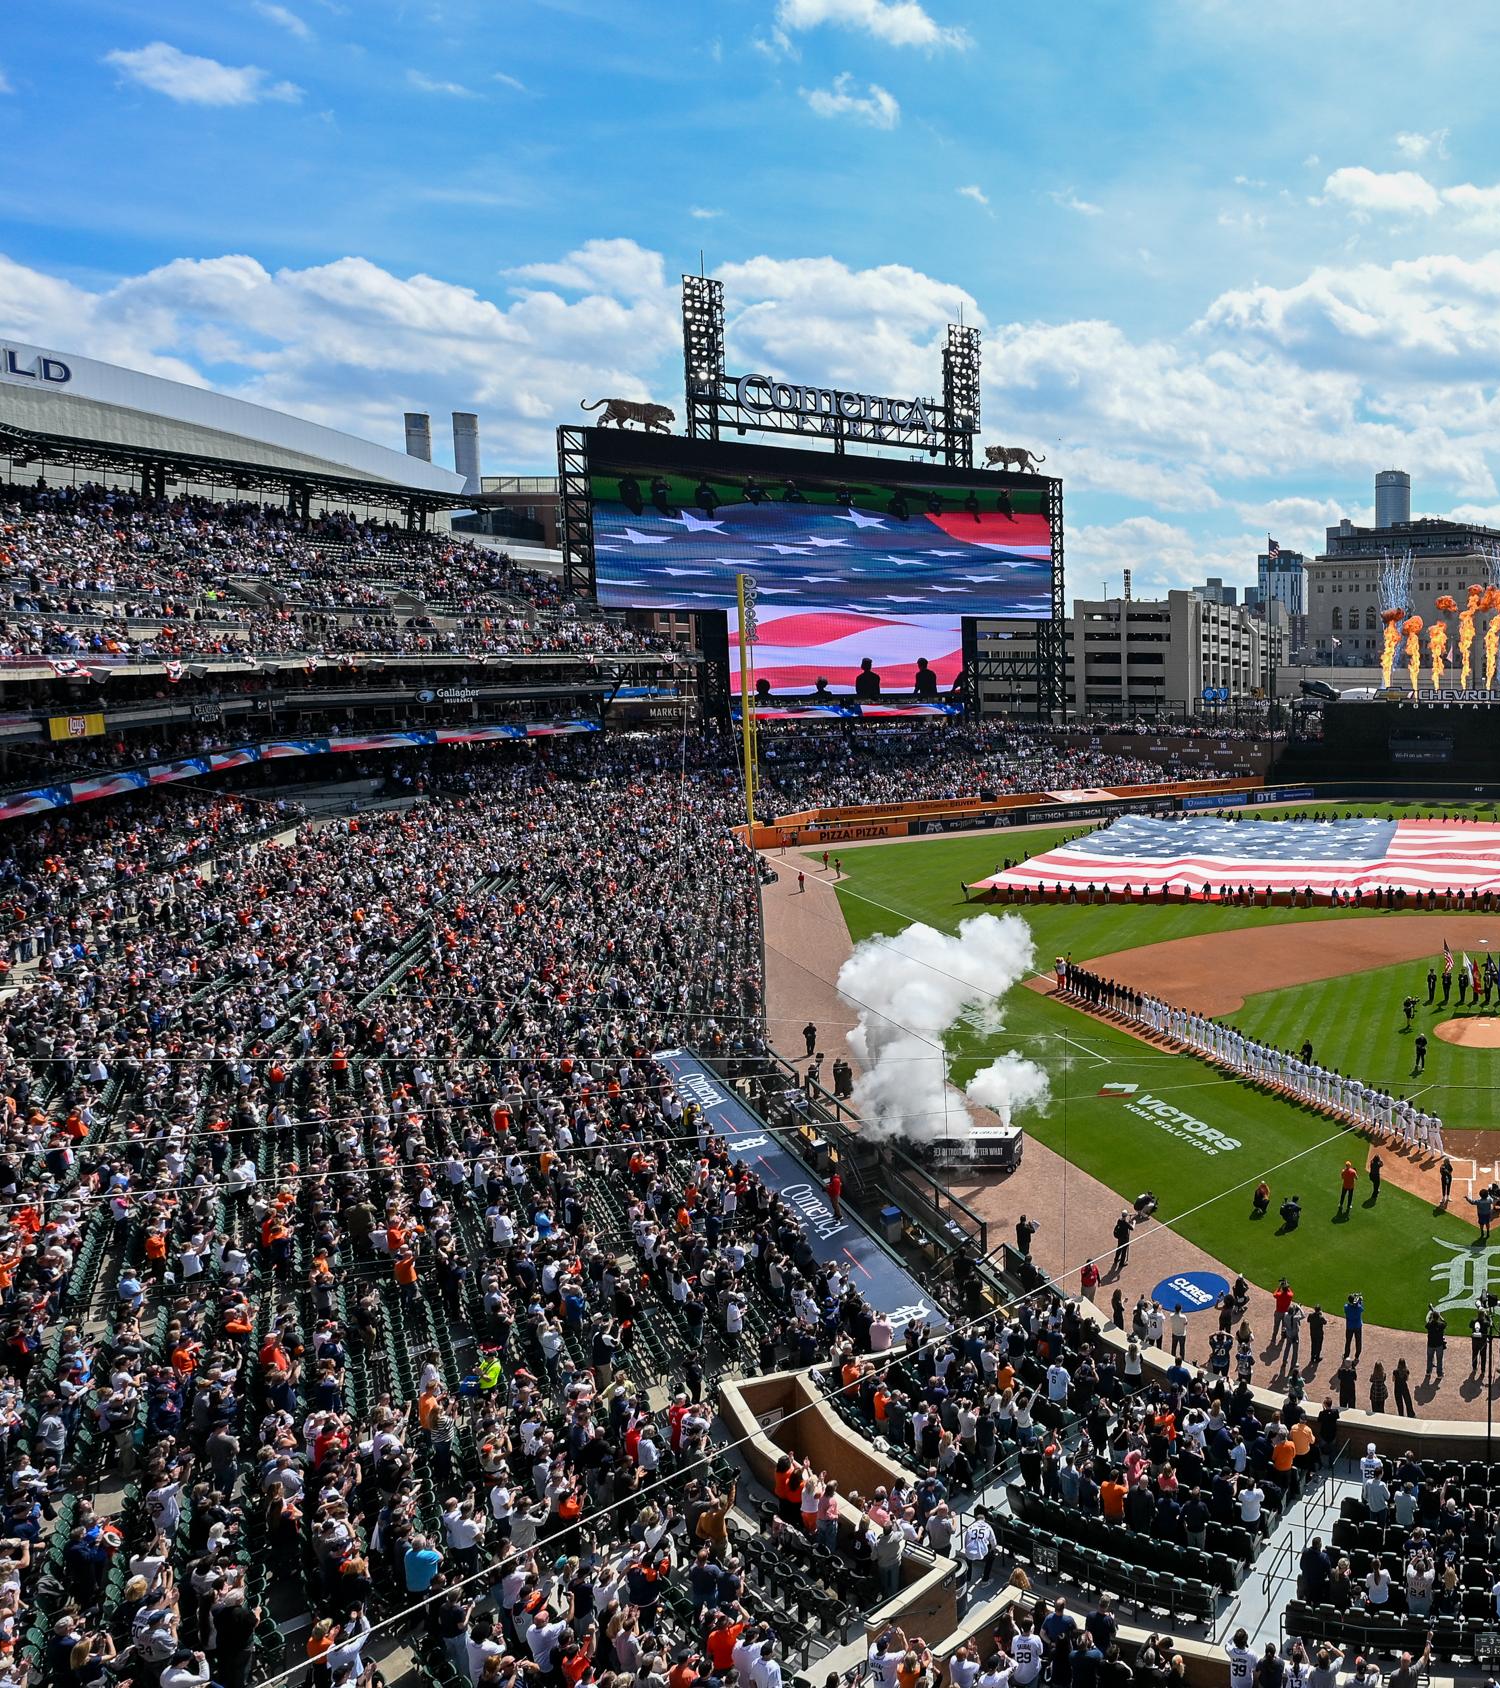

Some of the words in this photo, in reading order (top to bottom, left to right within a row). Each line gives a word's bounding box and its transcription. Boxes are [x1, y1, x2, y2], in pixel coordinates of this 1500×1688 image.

[0, 348, 72, 383] LD
[797, 415, 887, 438] PARK
[745, 588, 760, 642] Rocket
[436, 687, 480, 699] Gallagher
[650, 706, 683, 718] MARKET
[1091, 737, 1100, 745] 23
[1256, 792, 1277, 802] DTE
[874, 805, 904, 814] DELIVERY
[950, 800, 977, 808] DELIVERY
[820, 829, 854, 841] PIZZA!
[856, 826, 889, 838] PIZZA!
[1137, 1094, 1242, 1151] VICTORS
[1122, 1103, 1156, 1121] HOME
[1154, 1119, 1220, 1156] SOLUTIONS
[989, 1147, 1003, 1156] WHAT
[1173, 1277, 1204, 1299] CURE
[1051, 1374, 1057, 1385] 6
[1364, 1469, 1376, 1479] 29
[970, 1529, 985, 1541] 35
[1410, 1588, 1426, 1598] 24
[1015, 1651, 1031, 1664] 29
[1231, 1662, 1246, 1678] 39
